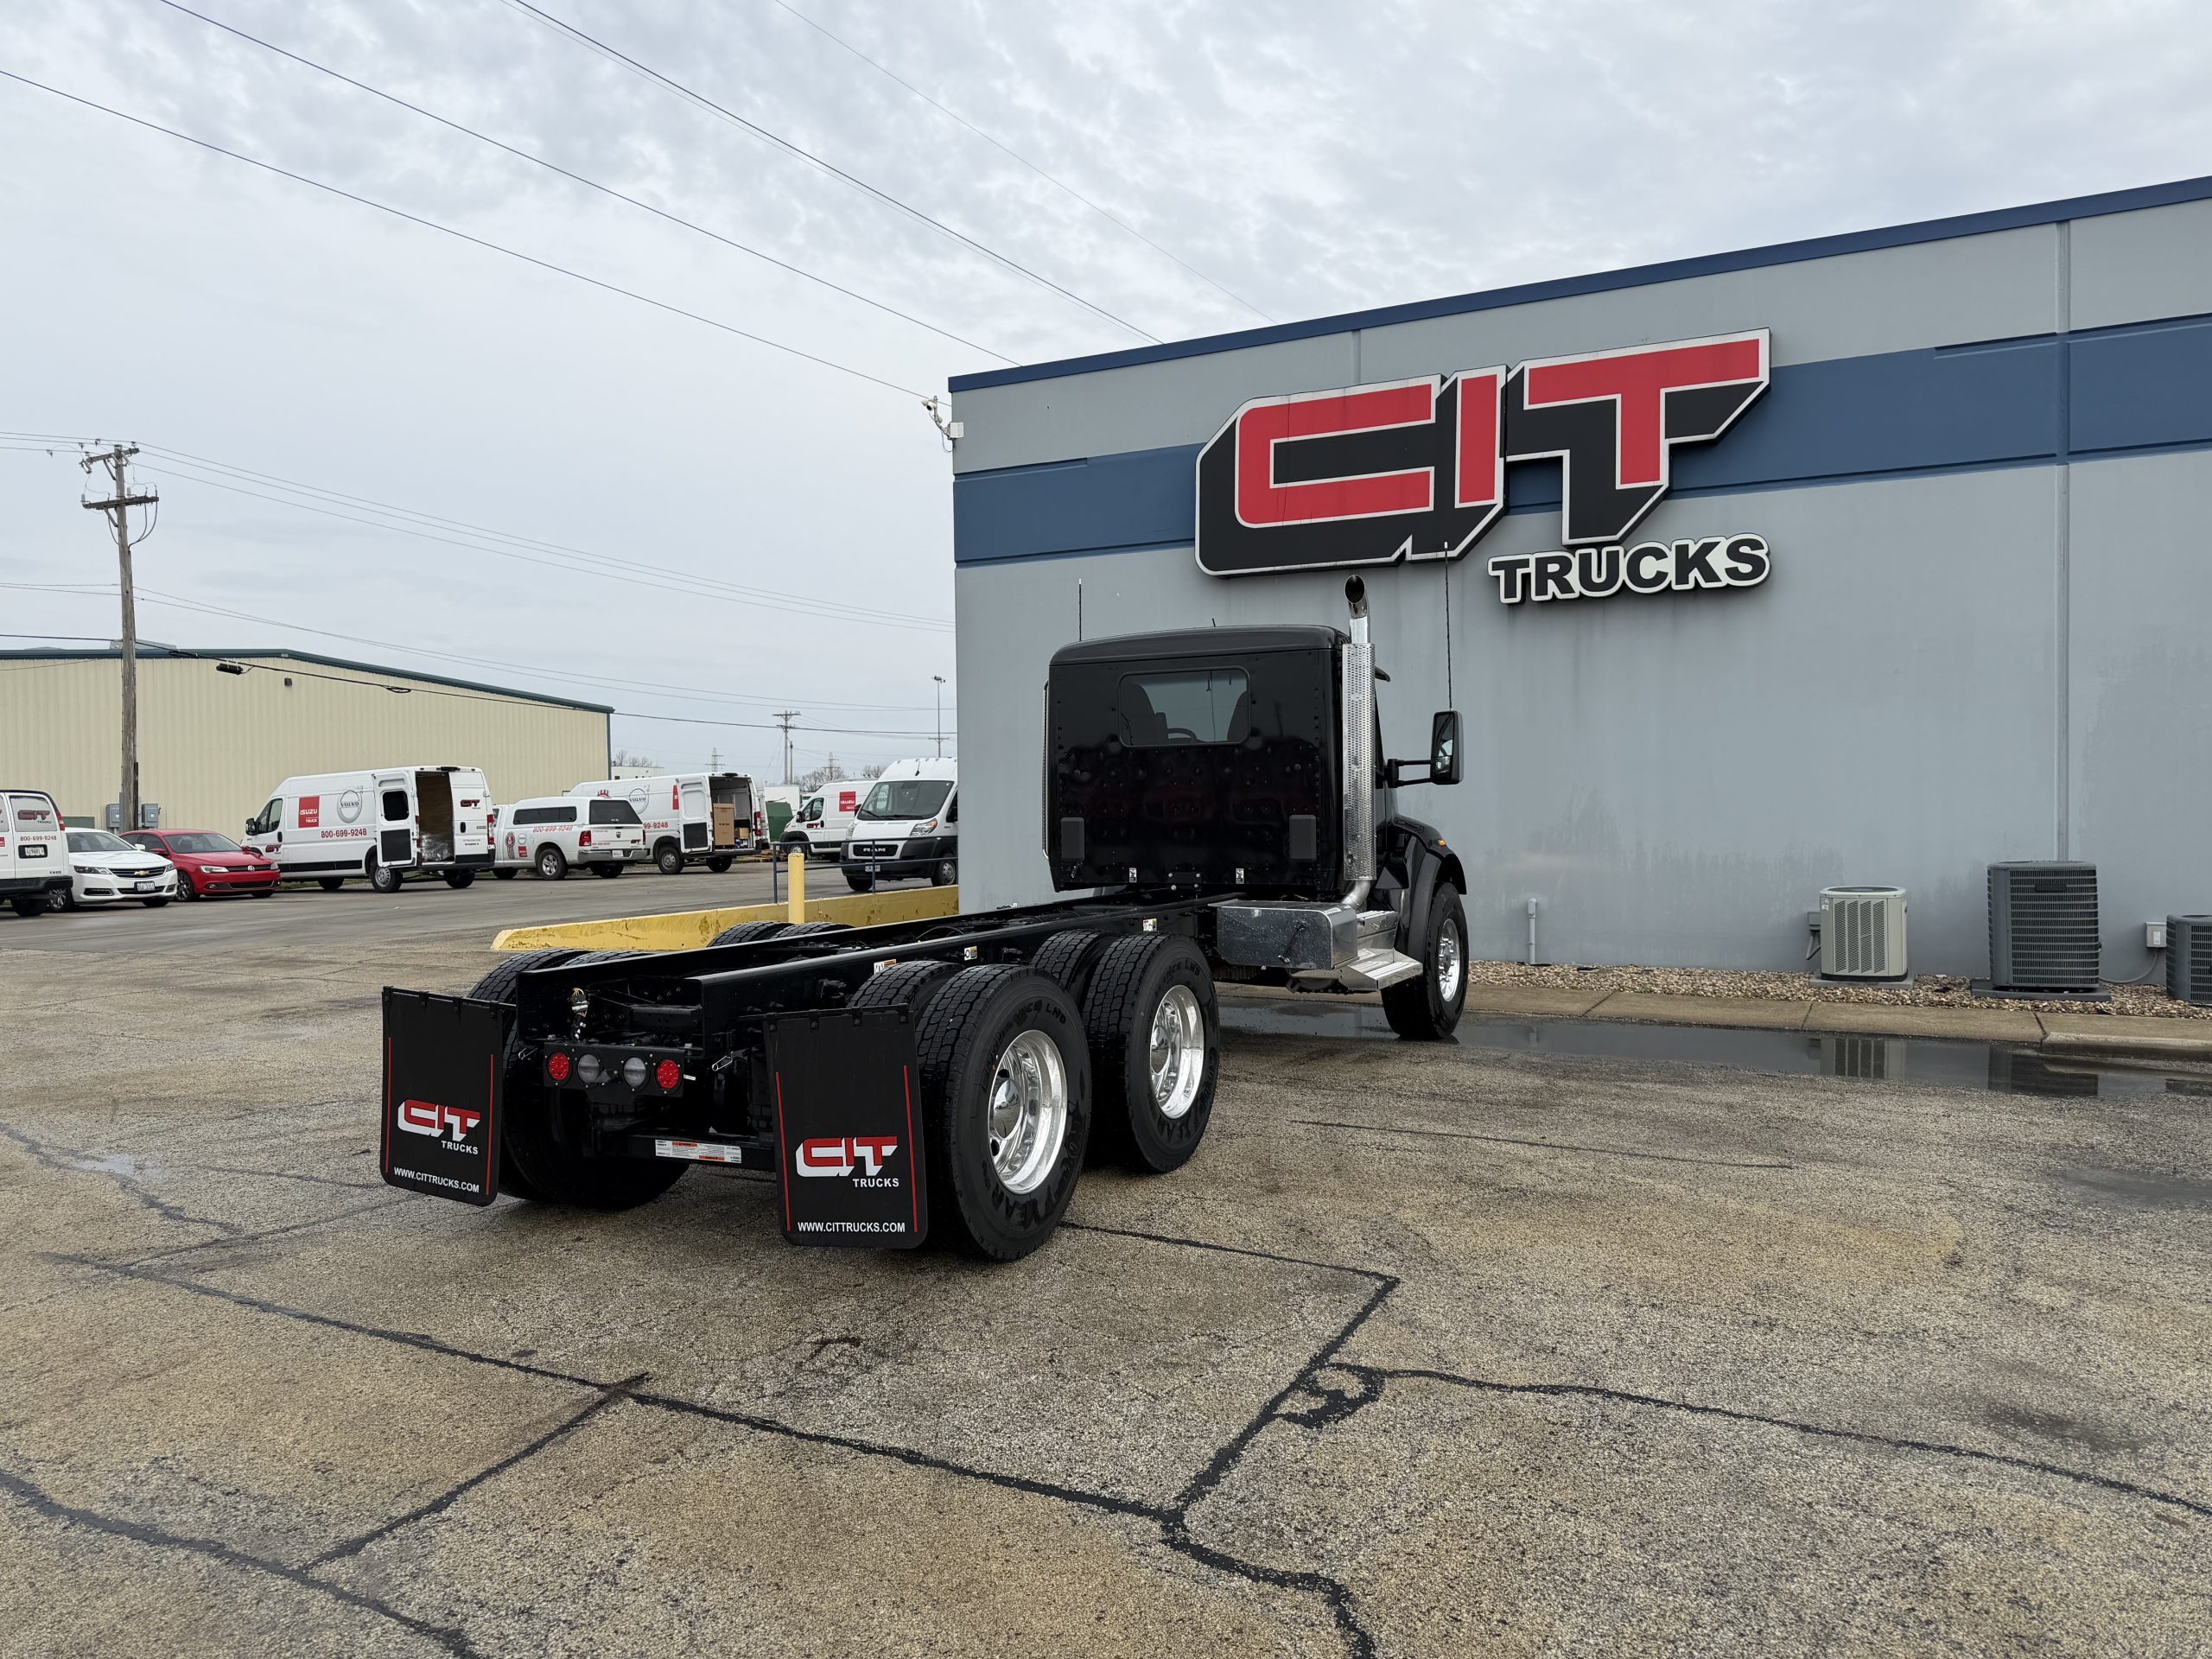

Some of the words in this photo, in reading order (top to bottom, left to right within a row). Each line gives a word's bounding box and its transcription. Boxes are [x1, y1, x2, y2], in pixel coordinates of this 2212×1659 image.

[1195, 327, 1770, 578] CIT
[1488, 533, 1770, 604] TRUCKS
[321, 828, 367, 838] 800-699-9248
[397, 1099, 480, 1142] CIT
[441, 1140, 479, 1155] TRUCKS
[795, 1136, 898, 1178] CIT
[393, 1166, 480, 1193] WWW.CITTRUCKS.COM
[852, 1178, 899, 1188] TRUCKS
[797, 1222, 906, 1233] WWW.CITTRUCKS.COM
